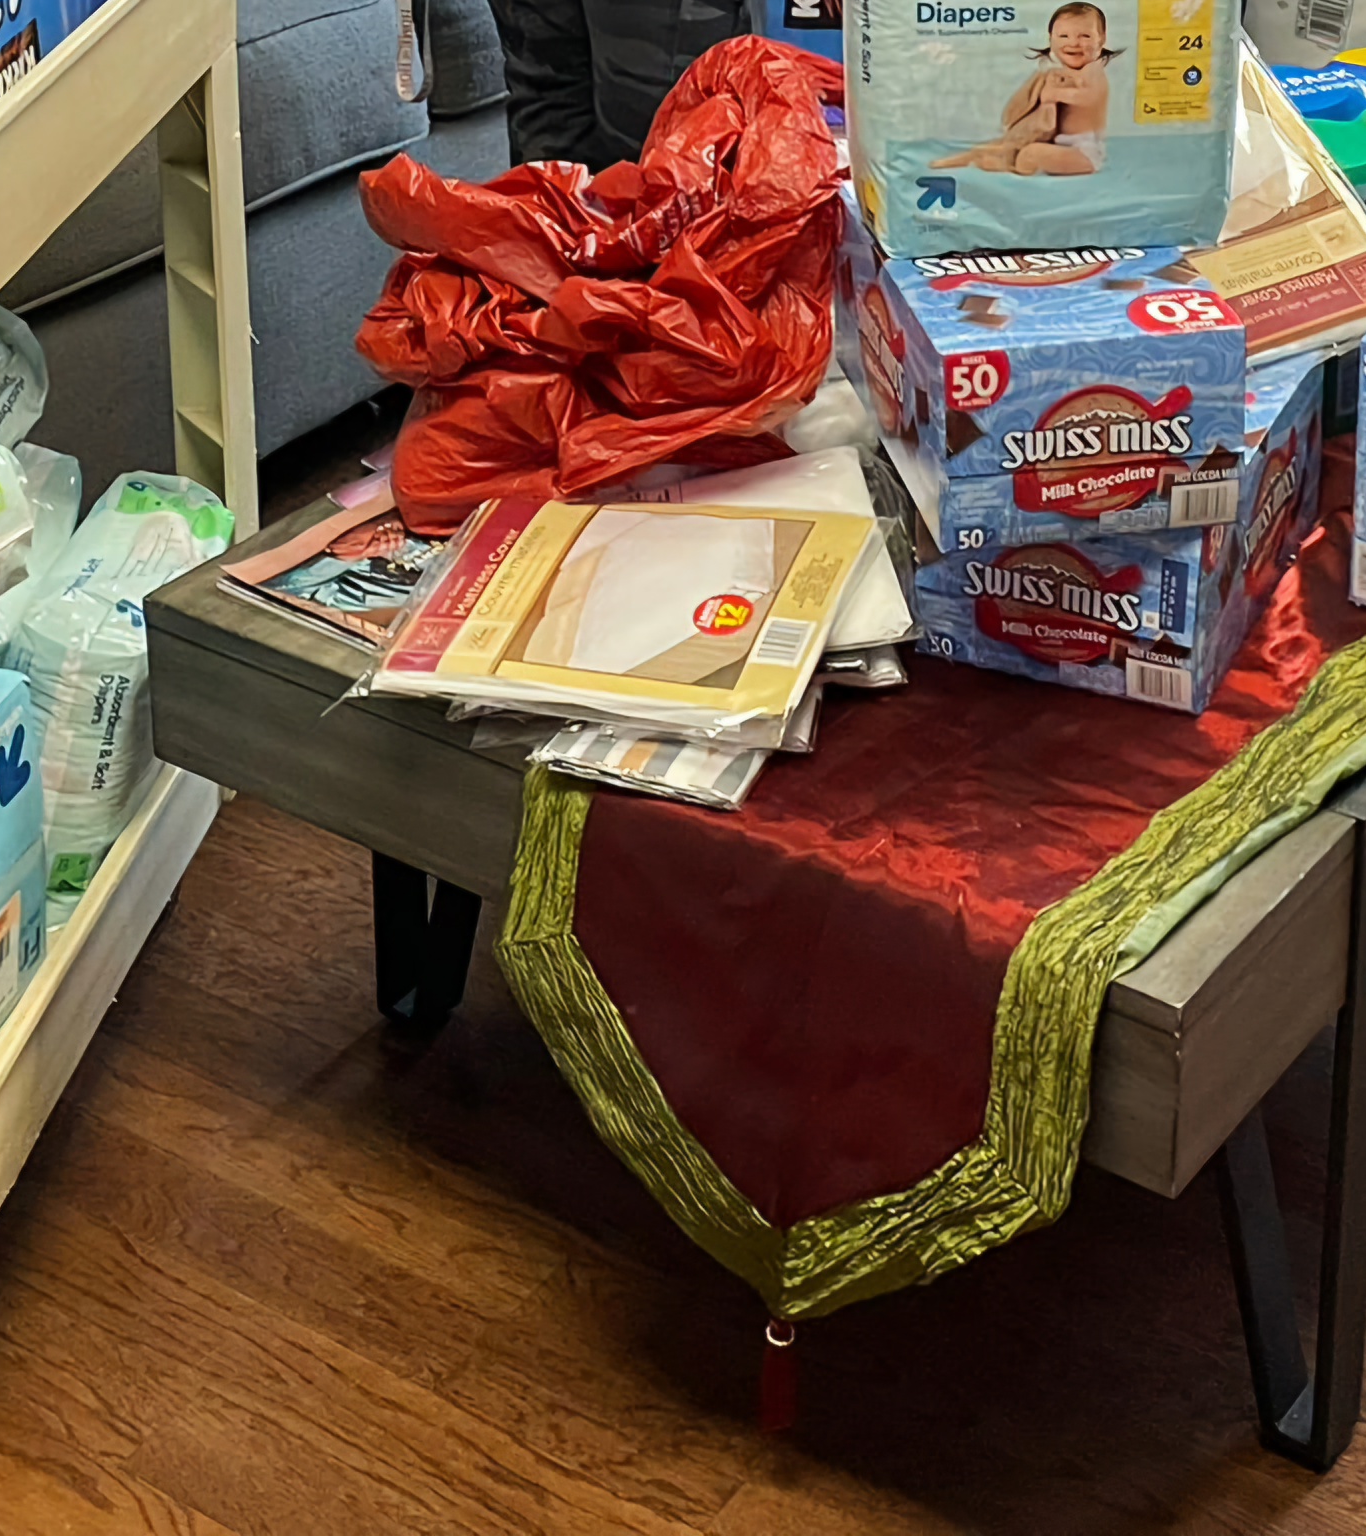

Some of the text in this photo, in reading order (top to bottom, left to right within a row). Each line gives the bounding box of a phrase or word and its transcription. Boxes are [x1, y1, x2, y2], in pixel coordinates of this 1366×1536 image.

[916, 3, 1016, 29] Diapers
[1178, 35, 1204, 52] 24
[1144, 297, 1225, 324] 50
[1240, 285, 1283, 310] Cover
[951, 363, 999, 400] 50
[1041, 465, 1156, 502] Milk Chocolate
[958, 529, 985, 550] 50
[714, 603, 745, 629] 12
[1034, 622, 1109, 645] Chocolate
